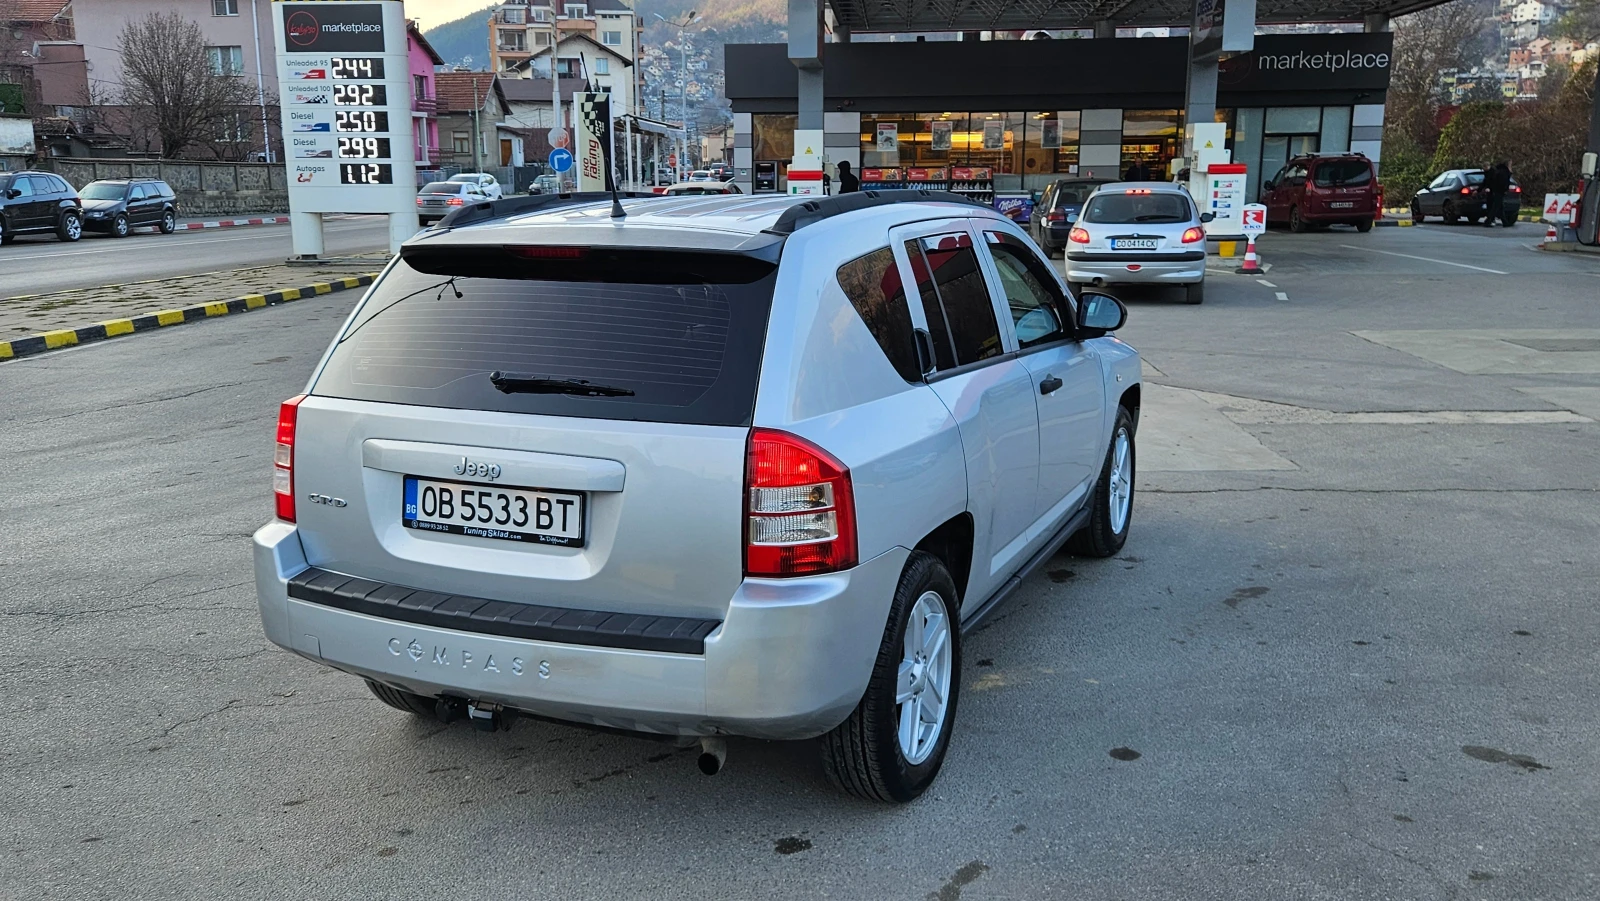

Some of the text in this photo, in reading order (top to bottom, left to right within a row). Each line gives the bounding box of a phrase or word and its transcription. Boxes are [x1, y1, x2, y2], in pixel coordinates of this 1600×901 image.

[322, 22, 381, 34] marketplace
[332, 58, 372, 78] 2.44
[1258, 50, 1389, 72] marketplace
[334, 85, 373, 105] 2.92
[336, 111, 376, 132] 2.50
[339, 138, 378, 158] 2.99
[589, 140, 599, 179] racing
[998, 199, 1022, 210] Milka
[1127, 239, 1145, 248] 0414
[1146, 240, 1156, 248] CK
[454, 456, 502, 481] Jeep
[308, 493, 347, 508] CRD
[406, 504, 416, 514] BG
[422, 486, 574, 532] OB 5533 BT
[463, 526, 522, 540] TuningSklad.com
